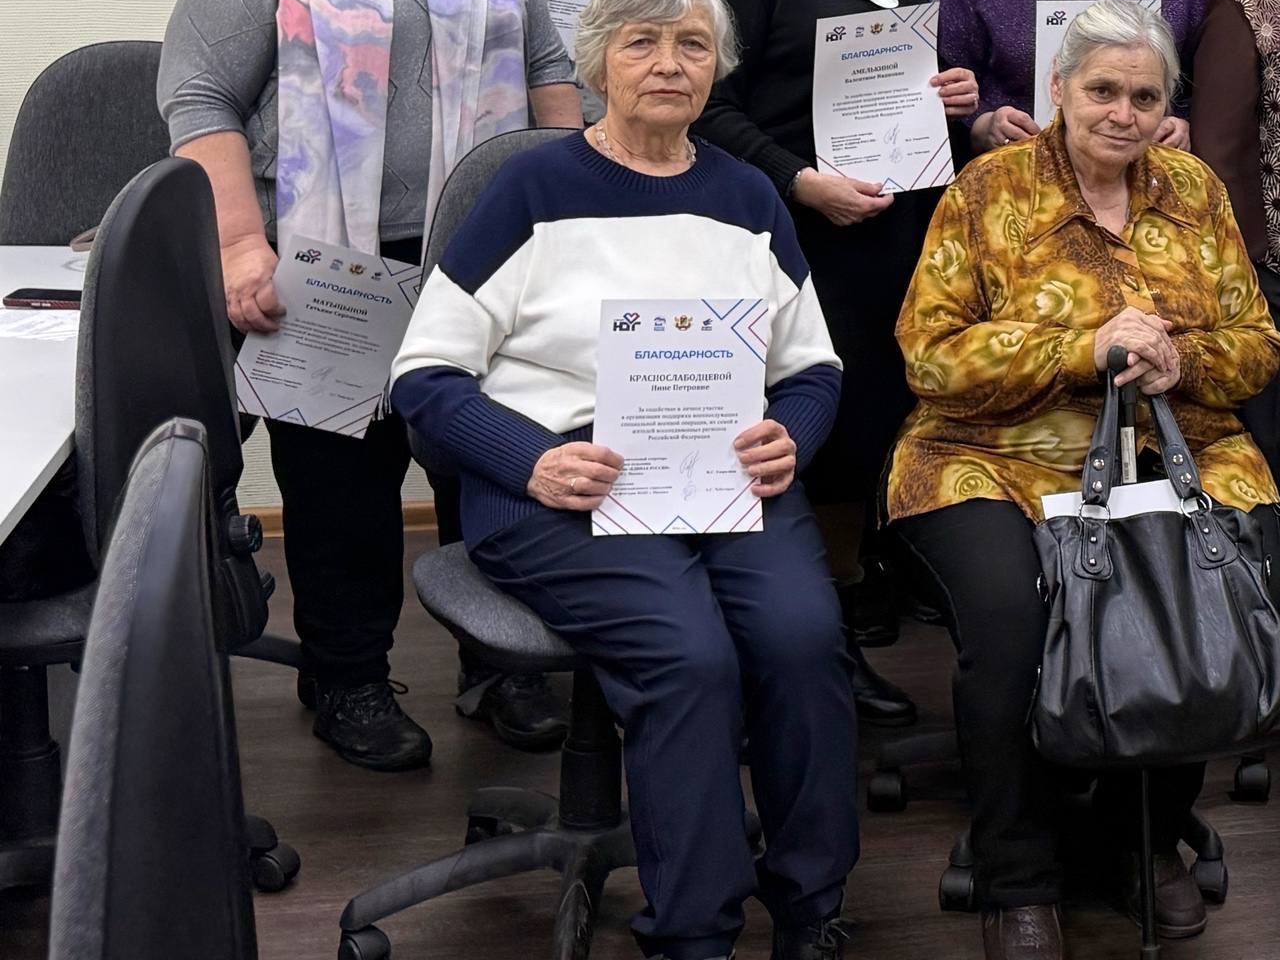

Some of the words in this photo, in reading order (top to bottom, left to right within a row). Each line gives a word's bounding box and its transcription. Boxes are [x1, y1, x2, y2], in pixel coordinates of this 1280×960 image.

[841, 44, 913, 60] БЛАГОДАРНОСТЬ
[305, 278, 392, 304] БЛАГОДАРНОСТЬ
[635, 350, 733, 360] БЛАГОДАРНОСТЬ
[629, 372, 732, 383] КРАСНОСЛАБОДЦЕВОЙ
[651, 384, 671, 392] Нине
[673, 384, 710, 392] Петровне
